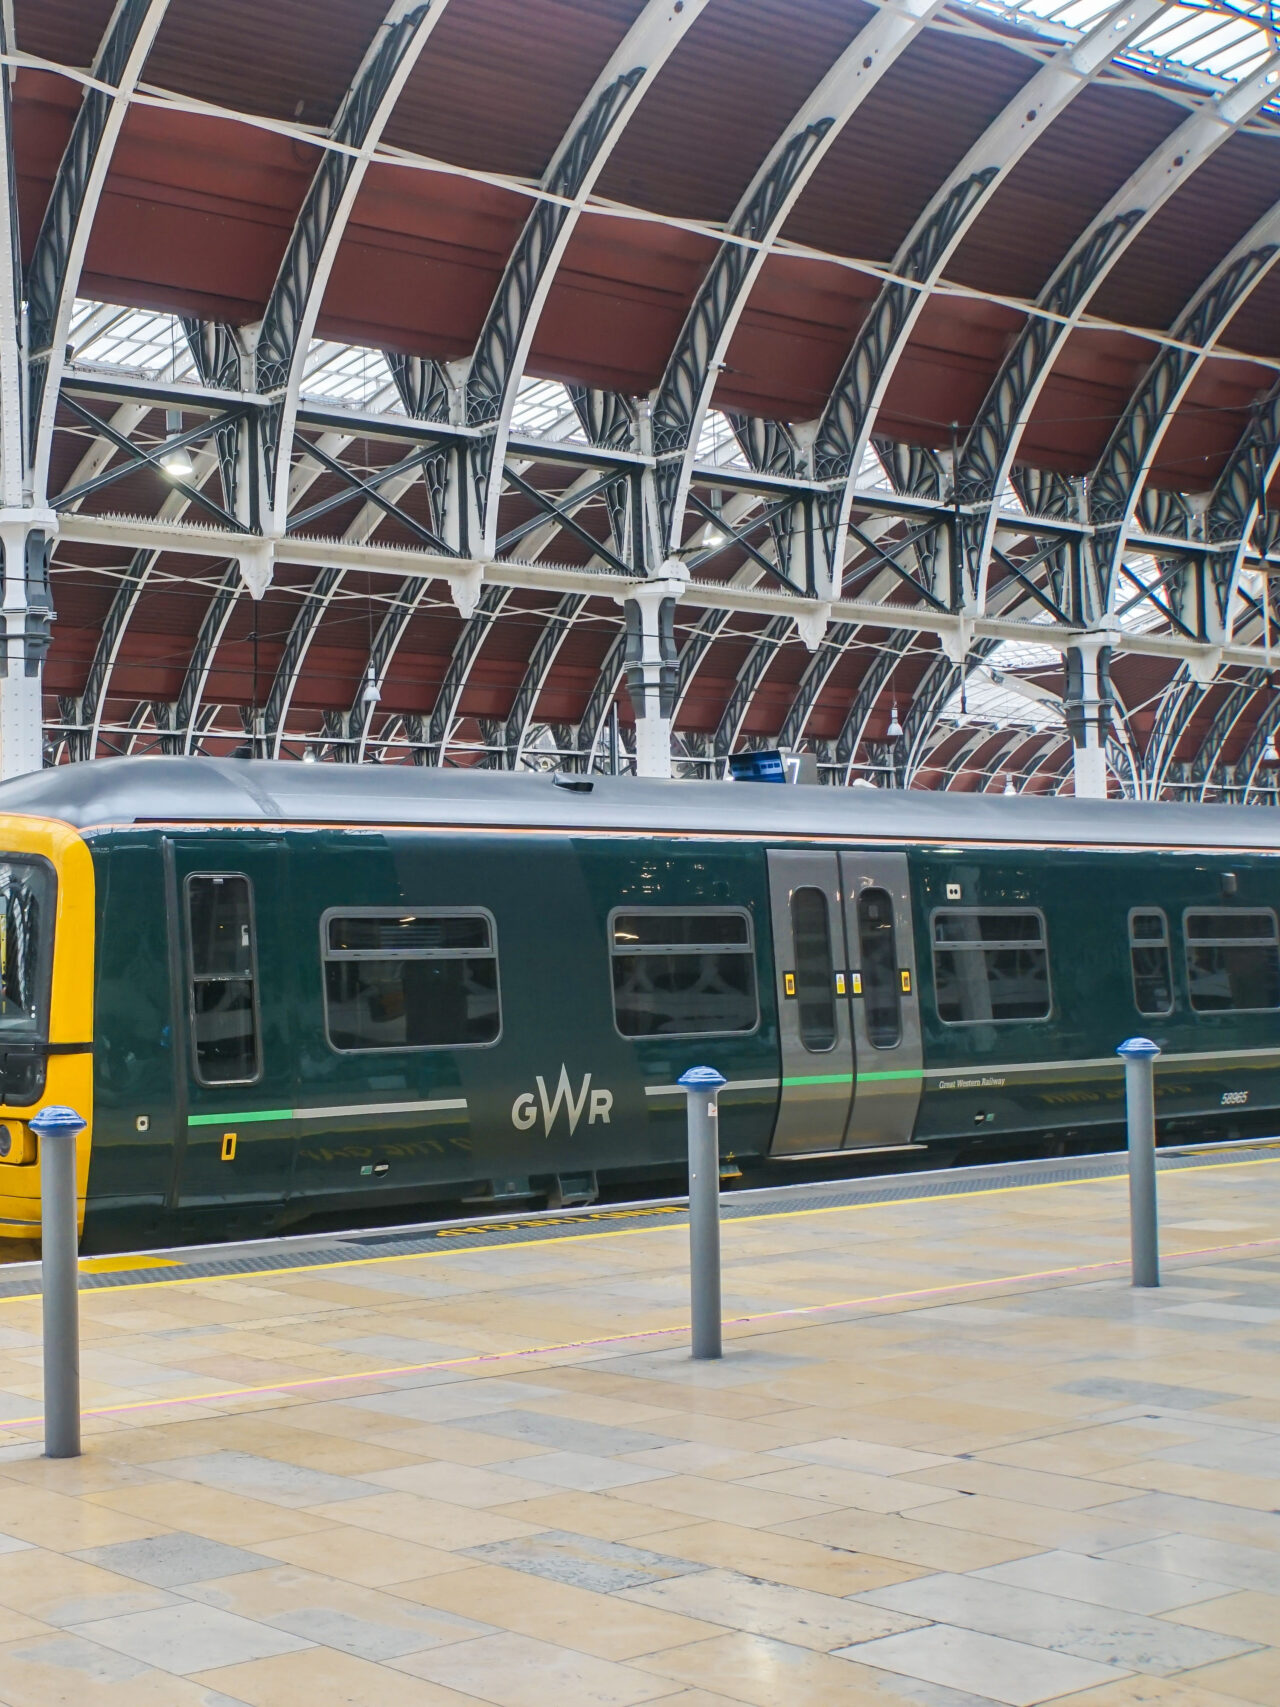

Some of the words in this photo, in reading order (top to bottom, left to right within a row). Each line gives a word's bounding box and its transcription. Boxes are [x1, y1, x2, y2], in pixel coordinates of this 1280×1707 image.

[786, 758, 801, 784] 7
[510, 1062, 614, 1139] GWR
[435, 1223, 519, 1238] GAP
